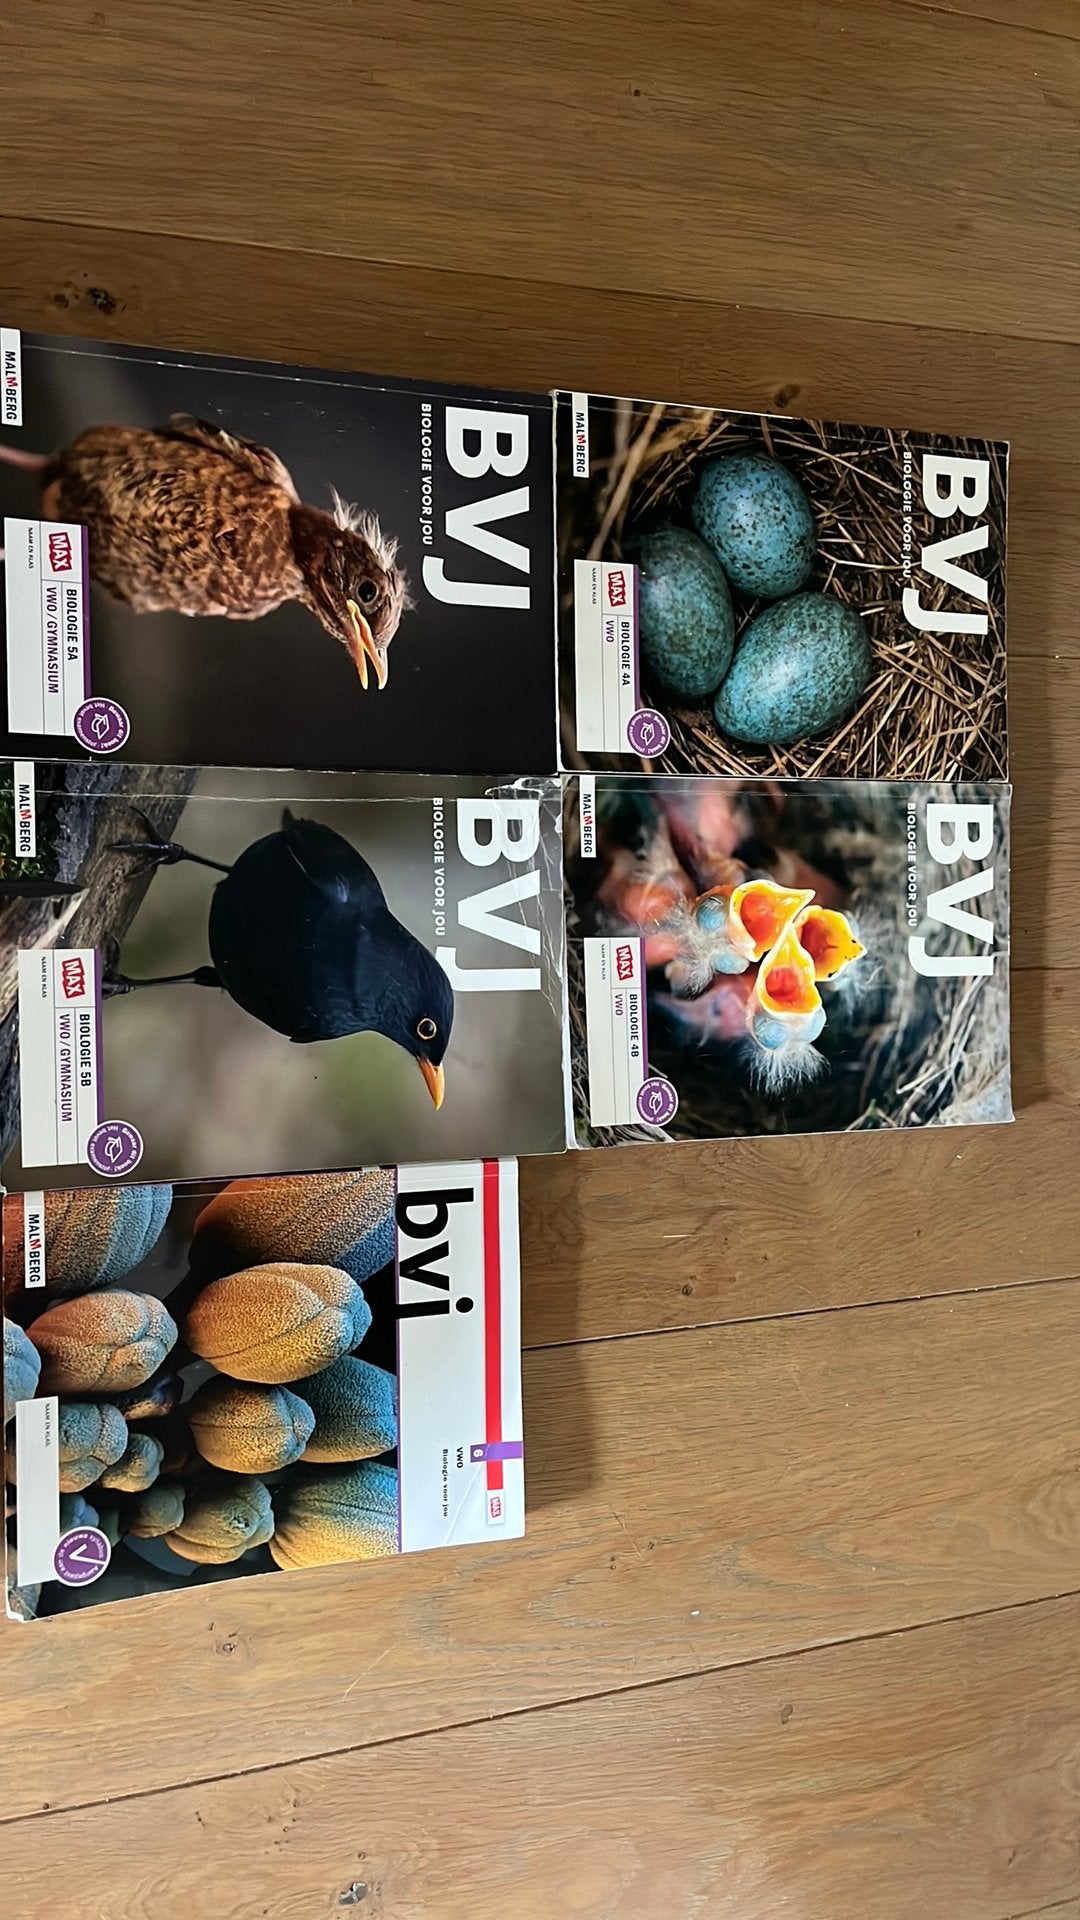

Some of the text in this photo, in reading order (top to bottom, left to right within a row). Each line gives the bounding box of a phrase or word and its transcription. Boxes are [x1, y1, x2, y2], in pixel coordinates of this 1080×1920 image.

[5, 350, 18, 420] MALMBERG
[419, 403, 433, 545] BIOLOGIE VOOR JOU
[575, 412, 587, 473] MALMBERG
[422, 406, 530, 610] BVJ
[900, 451, 912, 578] BIOLOGIE VOOR JOU
[28, 545, 34, 553] EN
[50, 533, 71, 571] MAX
[902, 454, 990, 635] BVJ
[609, 572, 625, 606] MAX
[66, 588, 78, 661] BIOLOGIE 5A
[605, 620, 615, 643] VWO
[621, 621, 631, 686] BIOLOGIE 4A
[19, 784, 32, 852] MALMBERG
[582, 793, 593, 853] MALMBERG
[432, 797, 446, 936] BIOLOGIE VOOR JOU
[435, 798, 541, 992] BVJ
[906, 802, 917, 927] BIOLOGIE VOOR JOU
[908, 804, 994, 977] BVJ
[41, 974, 47, 982] EN
[63, 958, 84, 998] MAX
[617, 946, 633, 980] MAX
[614, 993, 623, 1016] VWO
[629, 994, 640, 1058] BIOLOGIE 4B
[79, 1014, 92, 1087] BIOLOGIE 5B
[121, 1127, 137, 1149] Bewaar
[28, 1213, 42, 1283] MALMBERG
[473, 1449, 483, 1458] 6
[491, 1497, 501, 1517] MAX
